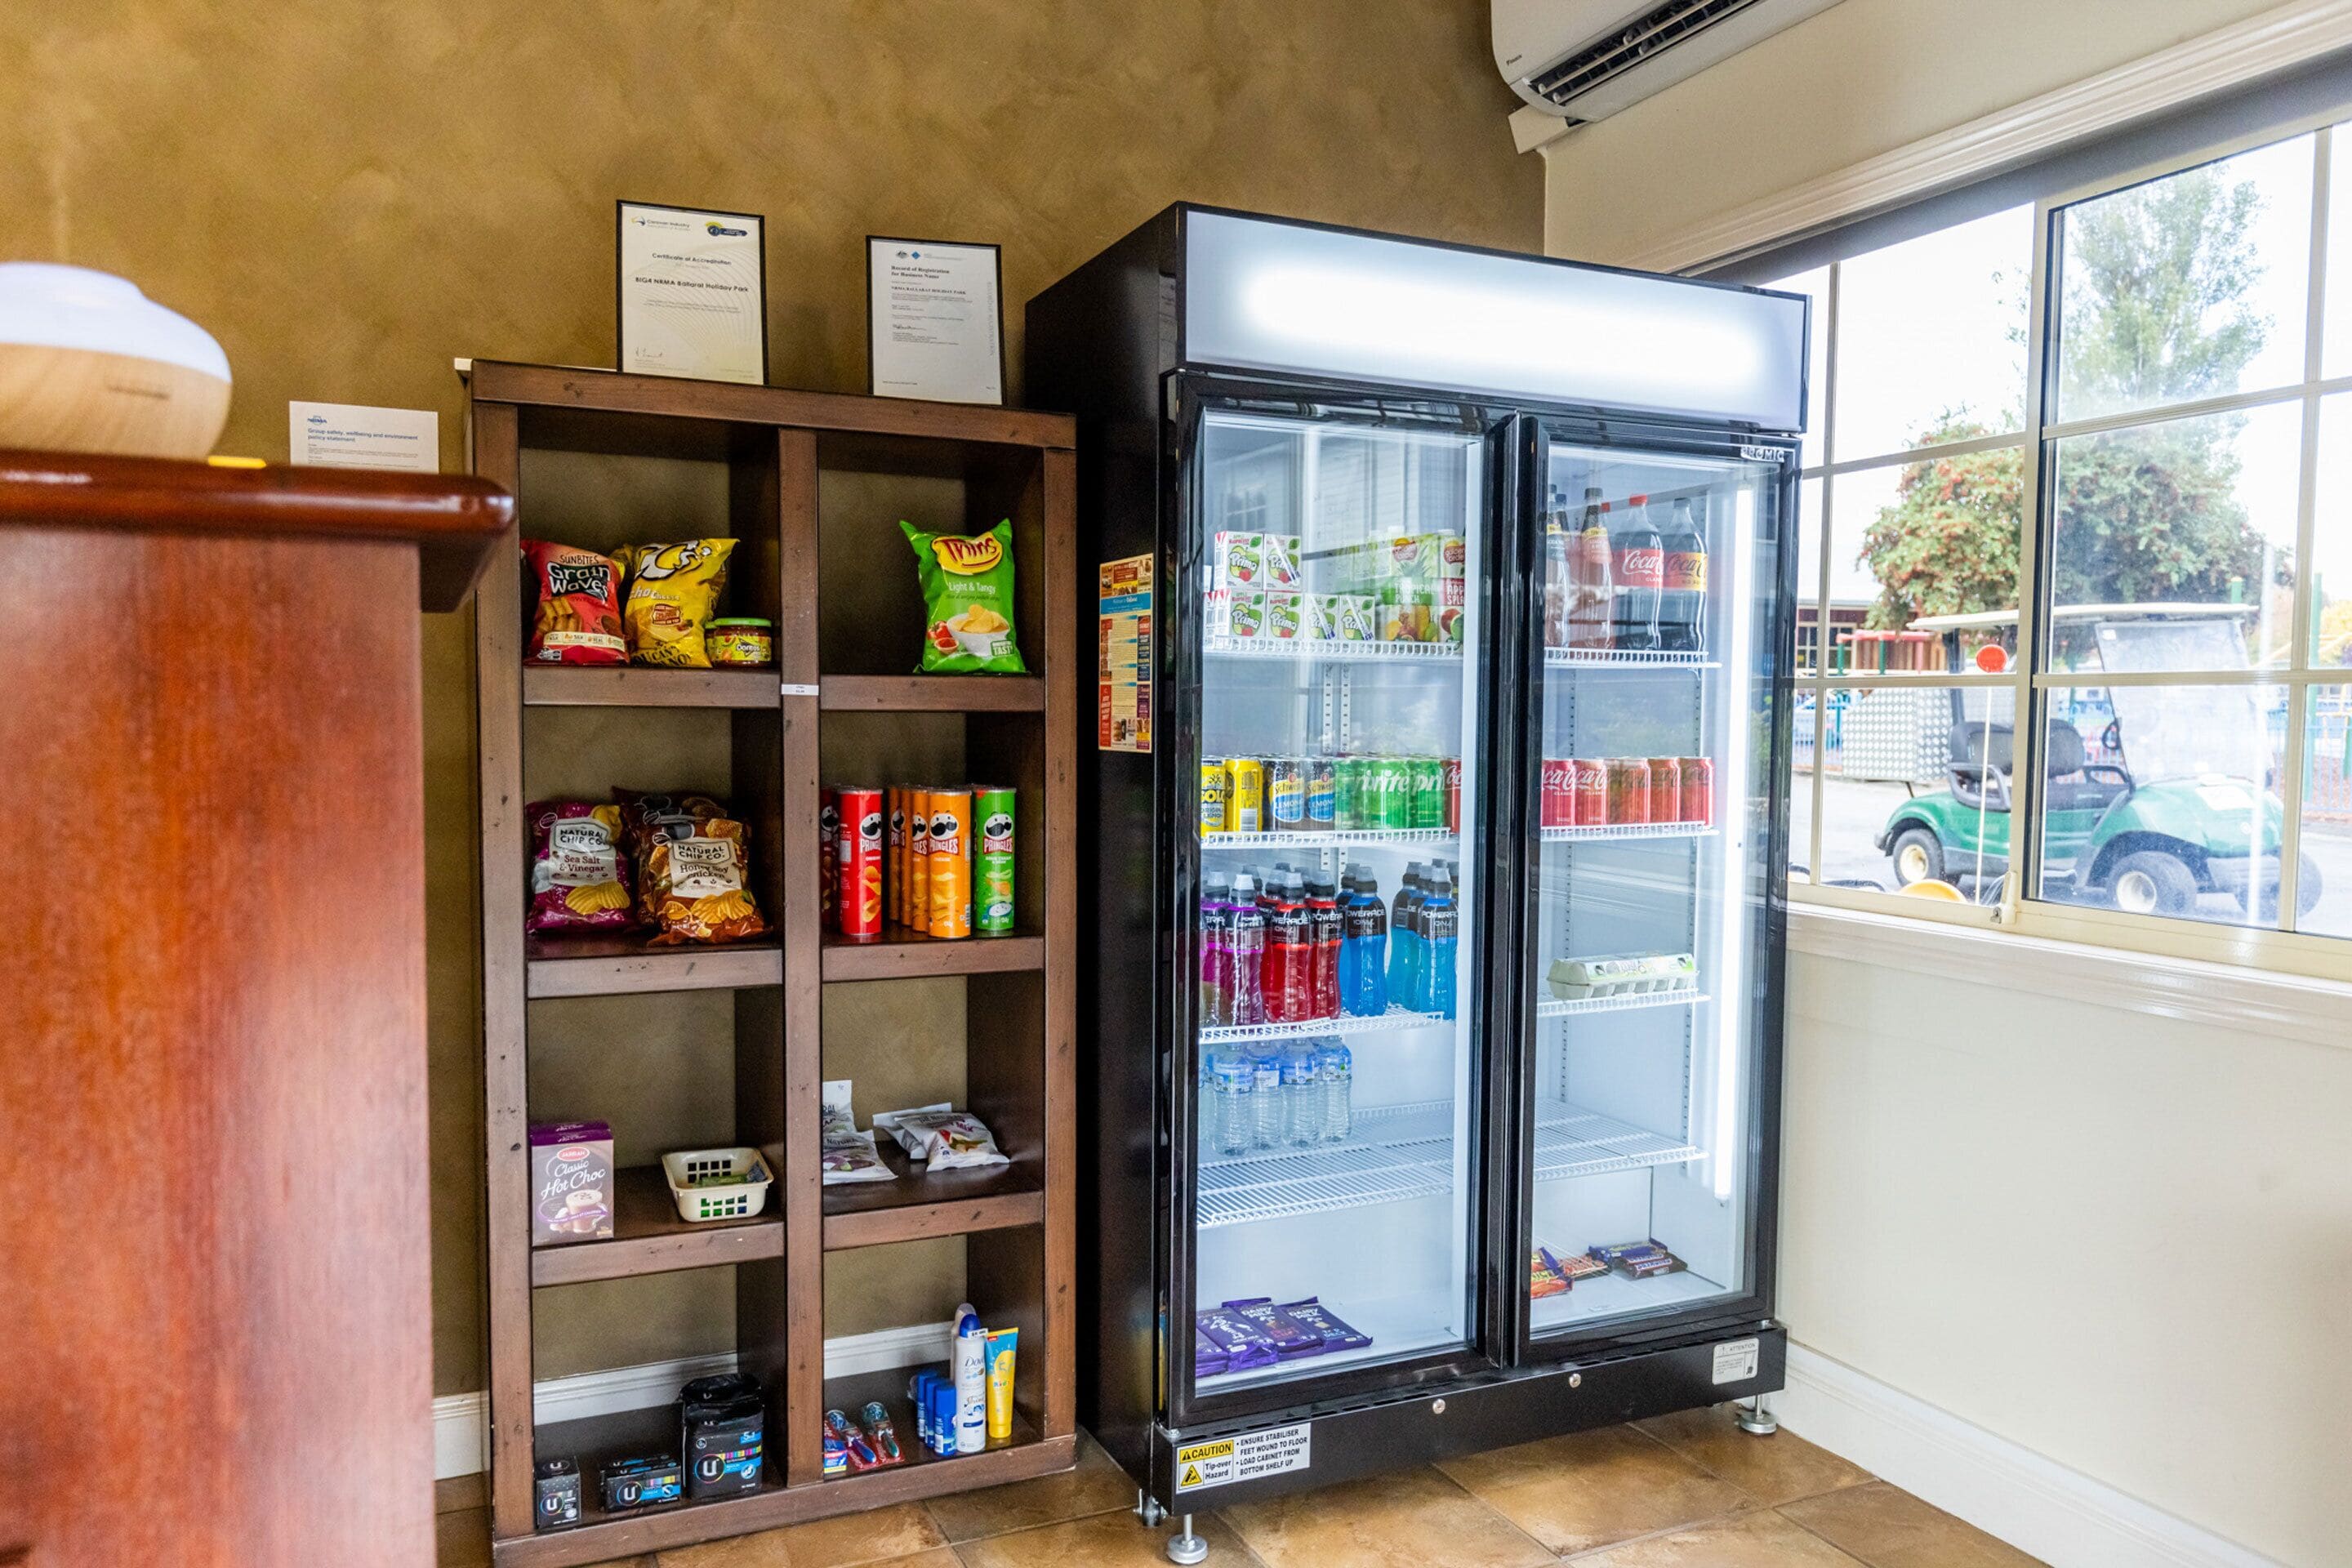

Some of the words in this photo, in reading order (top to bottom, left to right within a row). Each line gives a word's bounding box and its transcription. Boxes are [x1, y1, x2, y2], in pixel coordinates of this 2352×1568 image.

[652, 252, 684, 261] Certificate
[692, 256, 732, 266] Accreditation
[677, 280, 704, 288] Ballarat
[705, 283, 732, 292] Holiday
[933, 537, 997, 563] Thins
[560, 555, 599, 564] SUNBITES
[546, 561, 611, 581] Grain
[948, 581, 968, 594] Light
[969, 582, 975, 591] &
[977, 582, 996, 595] Tangy
[1446, 585, 1464, 595] APP
[737, 644, 761, 653] Doritos
[560, 835, 585, 844] CHIP
[983, 837, 1013, 853] PRINGLES
[678, 844, 724, 854] NATURAL
[929, 838, 959, 855] PRINGLES
[564, 854, 581, 863] Sea
[582, 855, 601, 864] Salt
[679, 851, 702, 859] CHIP
[568, 864, 606, 873] Vinegar
[679, 864, 710, 873] Honey
[1312, 912, 1343, 921] POWERA
[1347, 908, 1385, 917] OWERADE
[555, 1160, 589, 1177] Classic
[541, 1178, 570, 1200] Hot
[570, 1169, 606, 1189] Choc
[1241, 1435, 1264, 1446] ENSURE
[1265, 1429, 1299, 1441] STABILISER
[1192, 1443, 1232, 1459] CAUTION
[1240, 1447, 1255, 1456] FEET
[1256, 1442, 1278, 1453] WOUND
[1288, 1437, 1307, 1447] FLOOR
[1240, 1457, 1256, 1466] LOAD
[1257, 1451, 1282, 1463] CABINET
[1284, 1448, 1301, 1457] FROM
[1205, 1459, 1232, 1471] Tip-over
[1240, 1465, 1264, 1476] BOTTOM
[1265, 1461, 1284, 1472] SHELF
[1285, 1459, 1294, 1467] UP
[1205, 1469, 1229, 1480] Hazard
